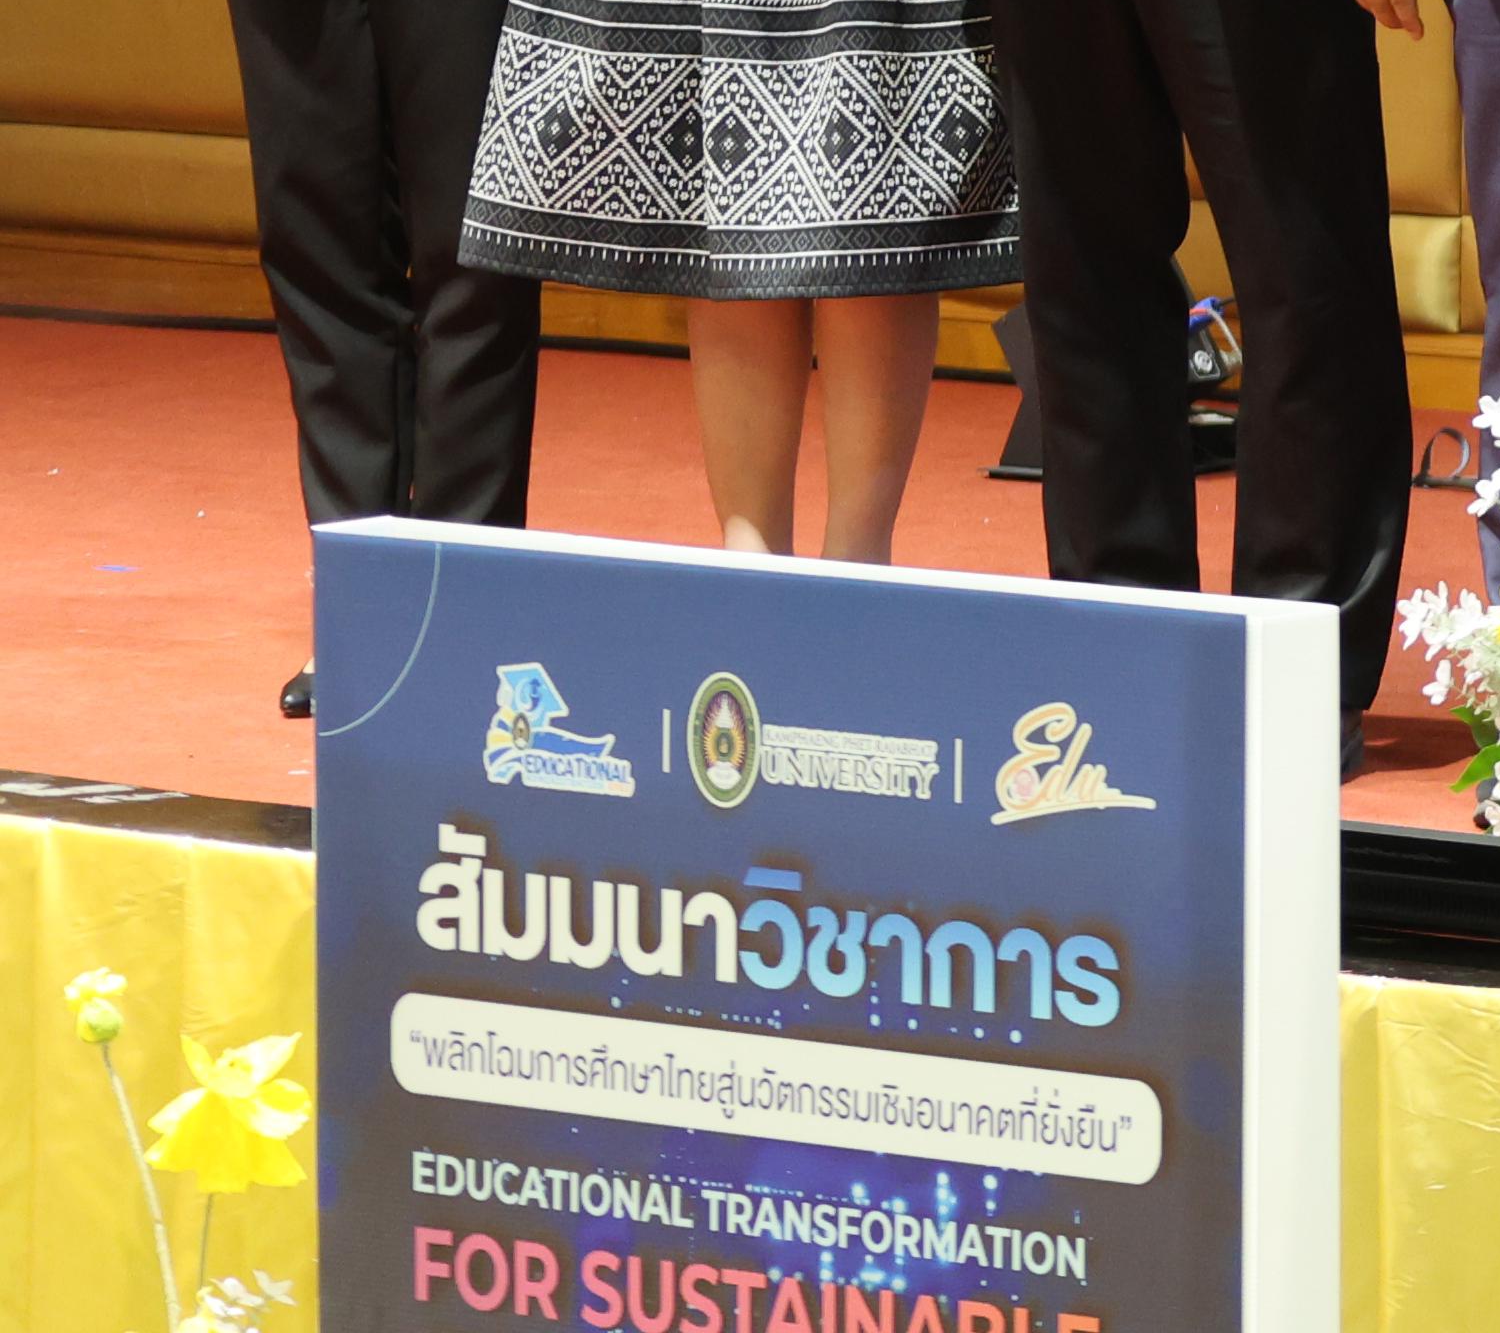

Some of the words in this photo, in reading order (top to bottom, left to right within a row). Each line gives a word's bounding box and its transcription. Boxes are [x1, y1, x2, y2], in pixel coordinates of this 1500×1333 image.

[762, 748, 938, 798] UNIVERSITY
[994, 702, 1122, 815] Edu
[416, 822, 1122, 1030] สัมมนาวิชาการ
[410, 1149, 695, 1230] EDUCATIONAL
[701, 1188, 1088, 1281] TRANSFORMATION
[412, 1225, 560, 1321] FOR
